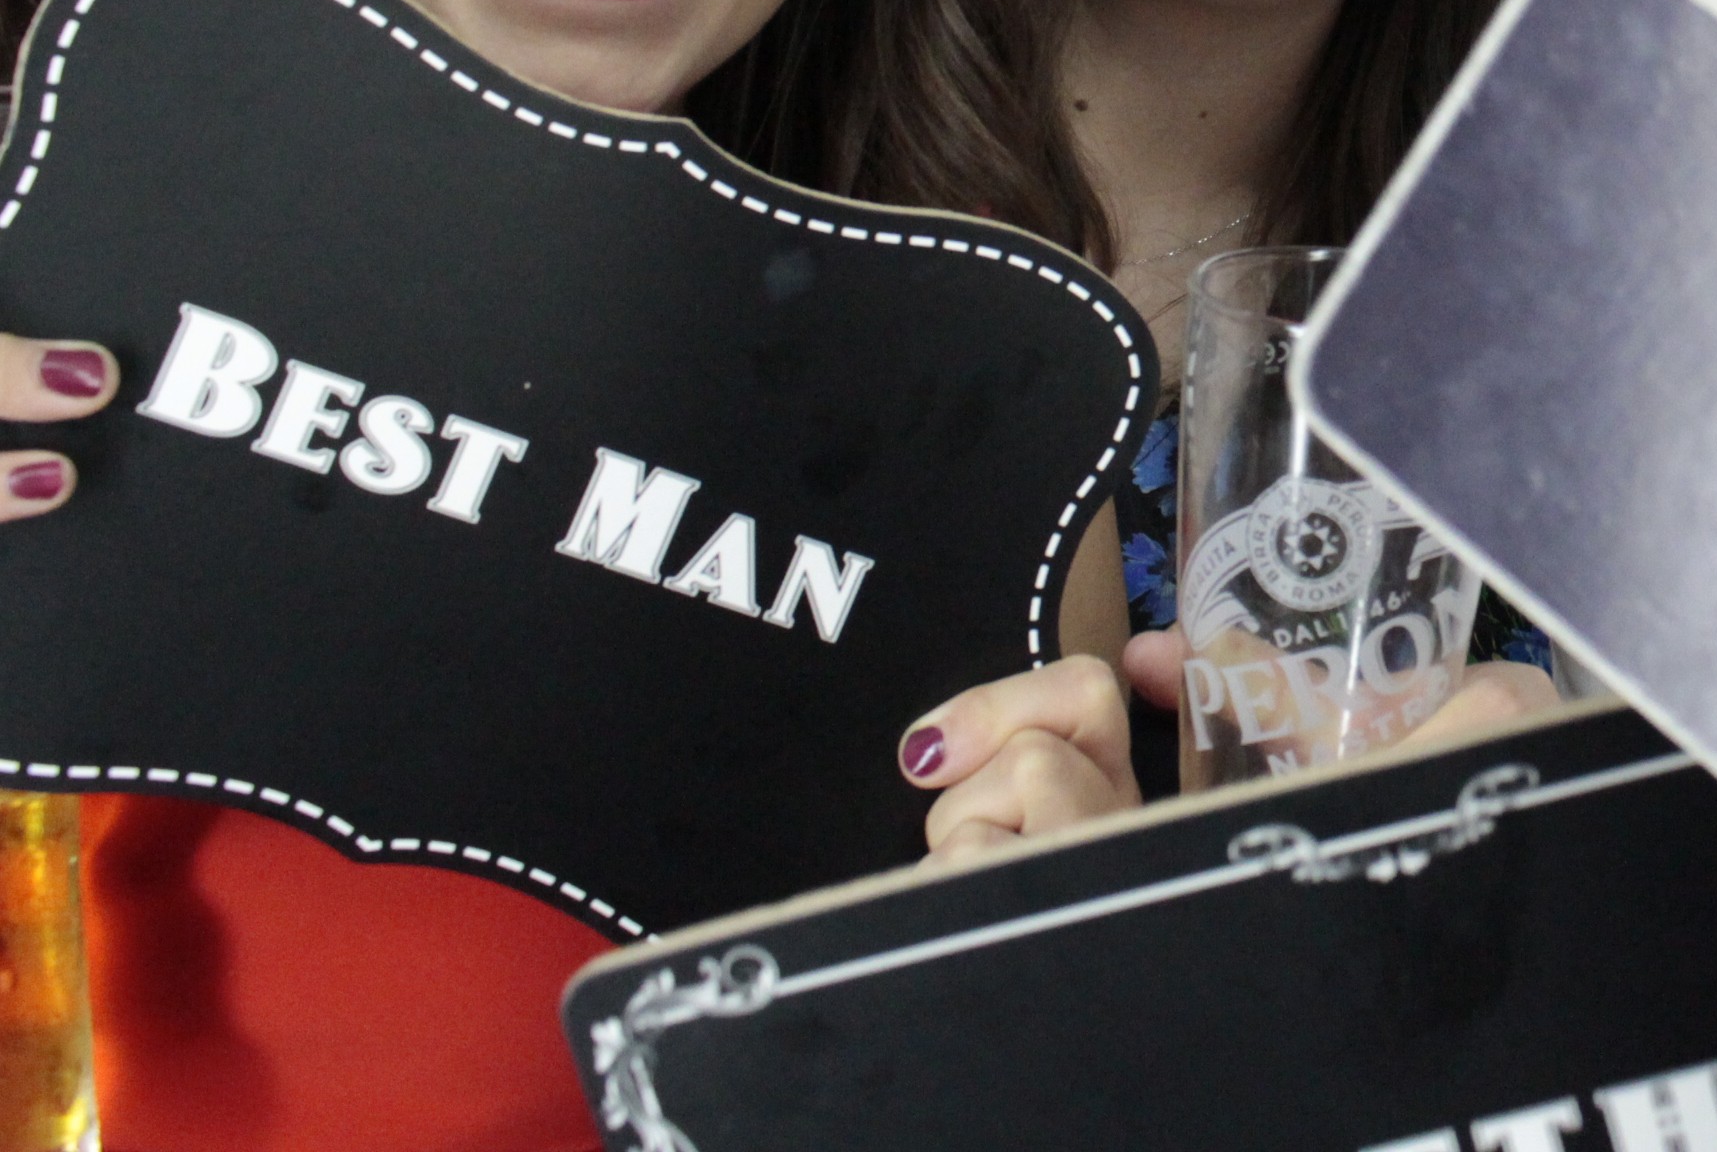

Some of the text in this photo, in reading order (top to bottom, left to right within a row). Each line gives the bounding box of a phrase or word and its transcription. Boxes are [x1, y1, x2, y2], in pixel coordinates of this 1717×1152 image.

[135, 301, 875, 644] BEST MAN
[1273, 590, 1404, 648] DAL 146
